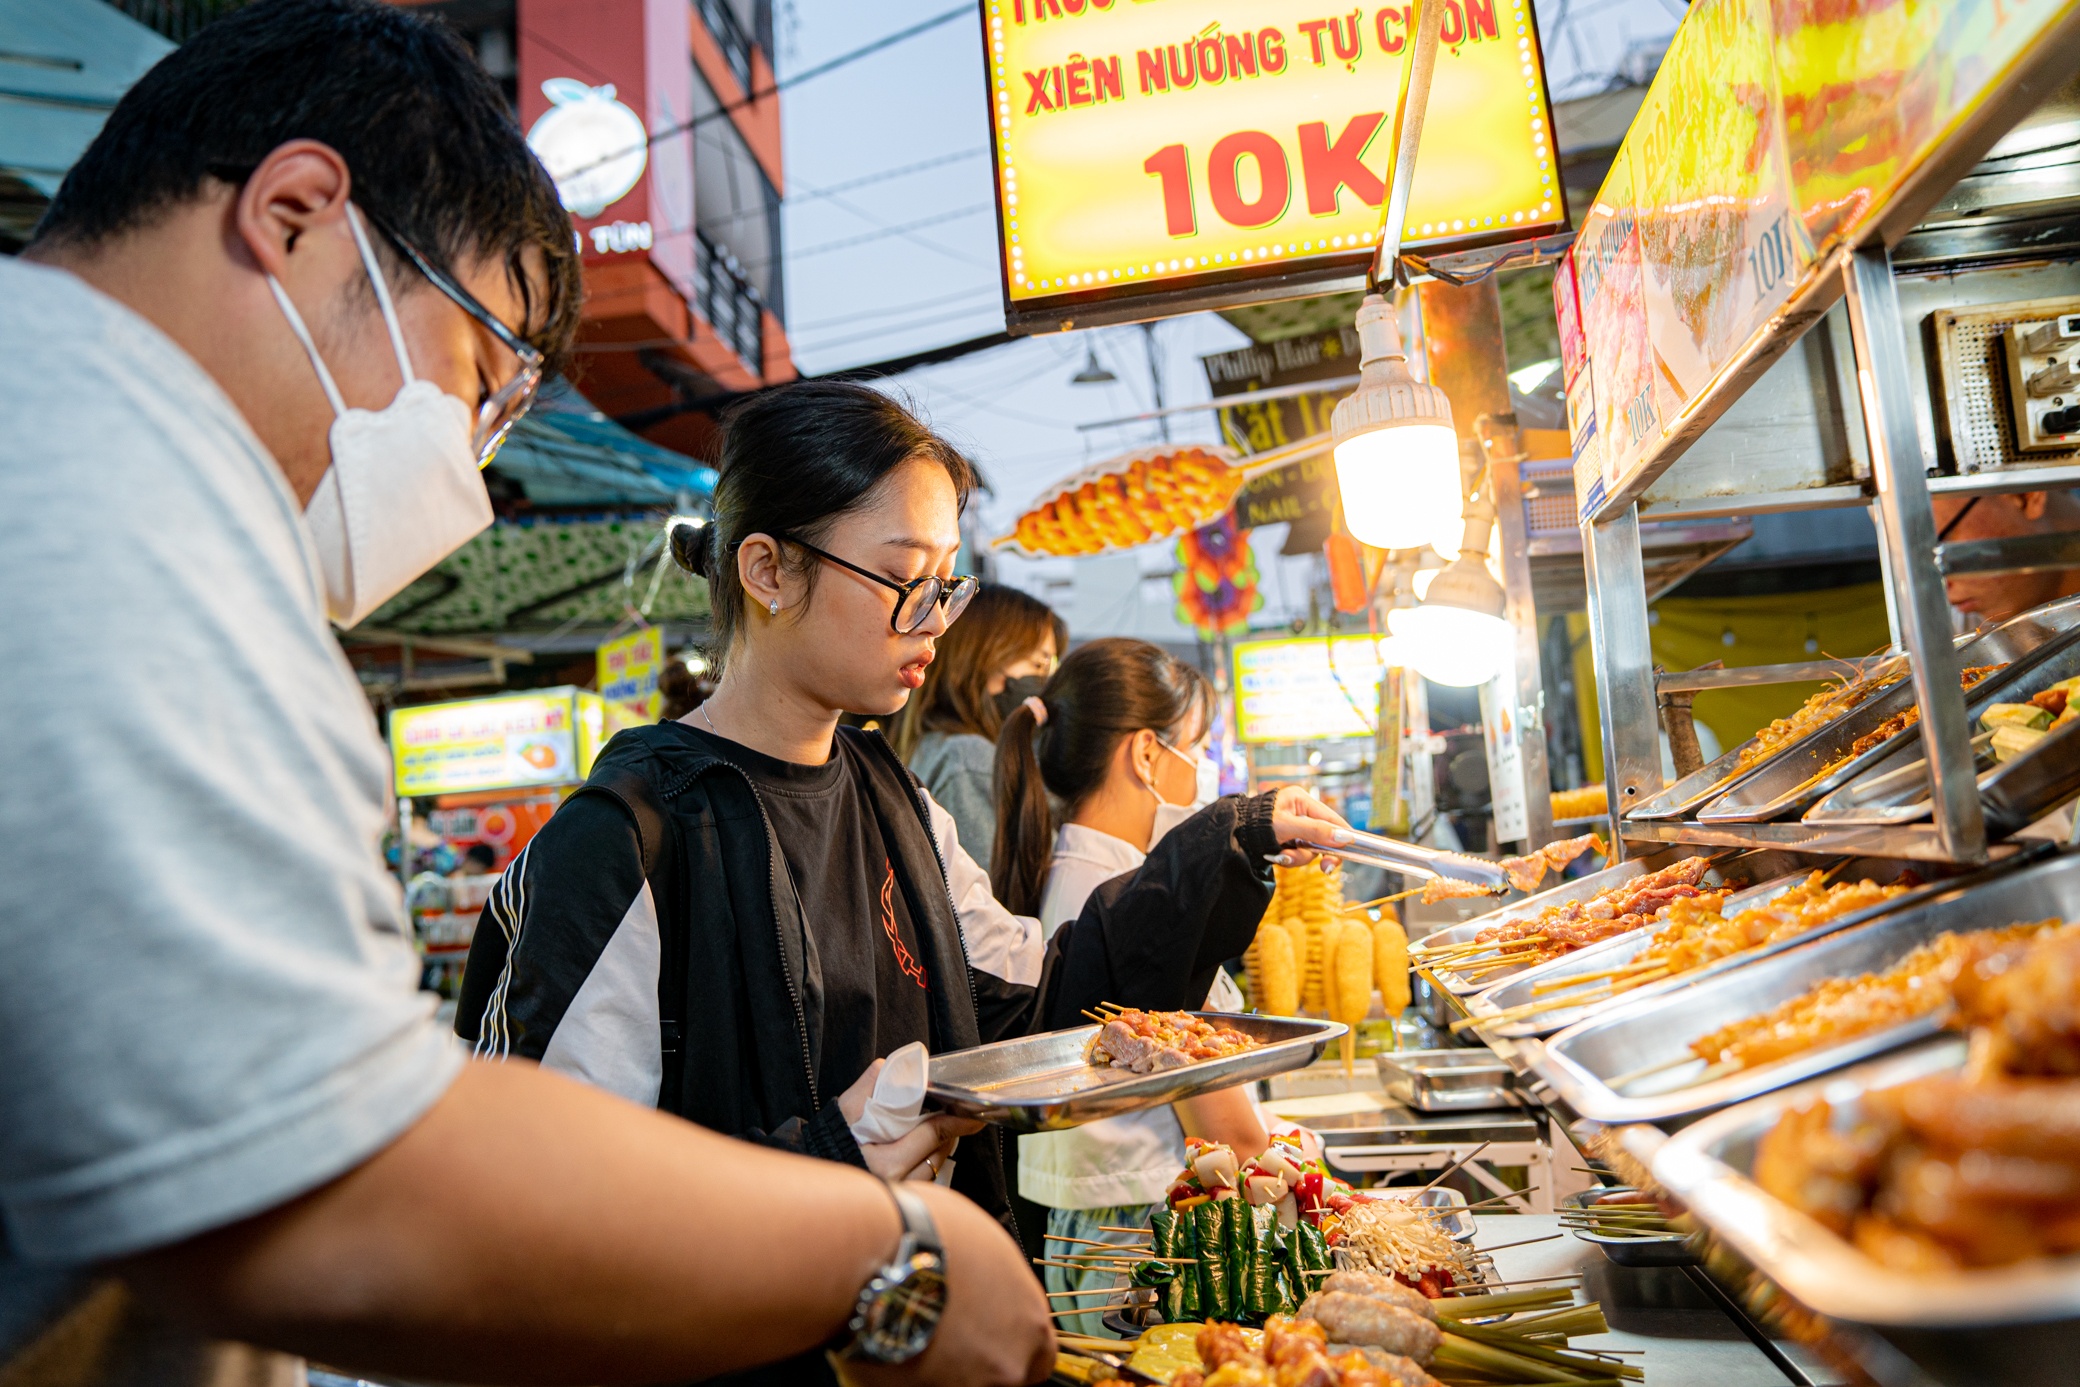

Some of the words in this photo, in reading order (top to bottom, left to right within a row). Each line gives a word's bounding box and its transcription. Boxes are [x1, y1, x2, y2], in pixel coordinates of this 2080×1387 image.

[1022, 54, 1125, 117] XIÊN
[1137, 21, 1288, 96] NƯỚNG
[1299, 8, 1362, 72] TỰ
[1144, 112, 1388, 239] 10K
[1628, 384, 1657, 447] 10K
